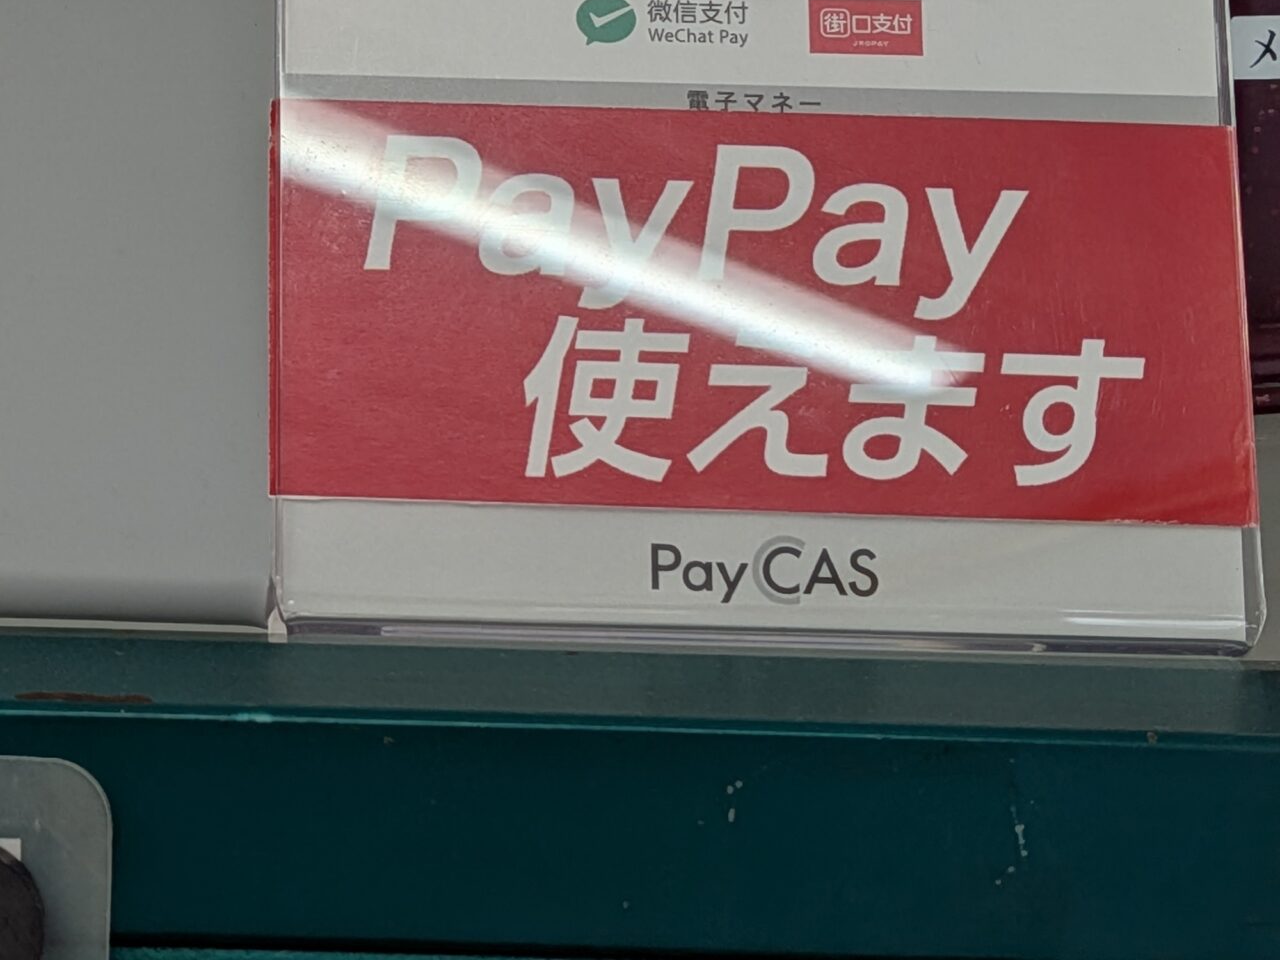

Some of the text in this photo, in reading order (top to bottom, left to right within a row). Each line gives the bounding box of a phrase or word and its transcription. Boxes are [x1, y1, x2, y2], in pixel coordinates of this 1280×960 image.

[647, 0, 749, 25] 微信支付
[823, 12, 913, 34] 街口支付
[648, 27, 749, 48] WeChat Pay
[687, 89, 821, 113] 電子マネー
[364, 135, 1030, 321] PayPay
[523, 316, 1145, 487] 使えます
